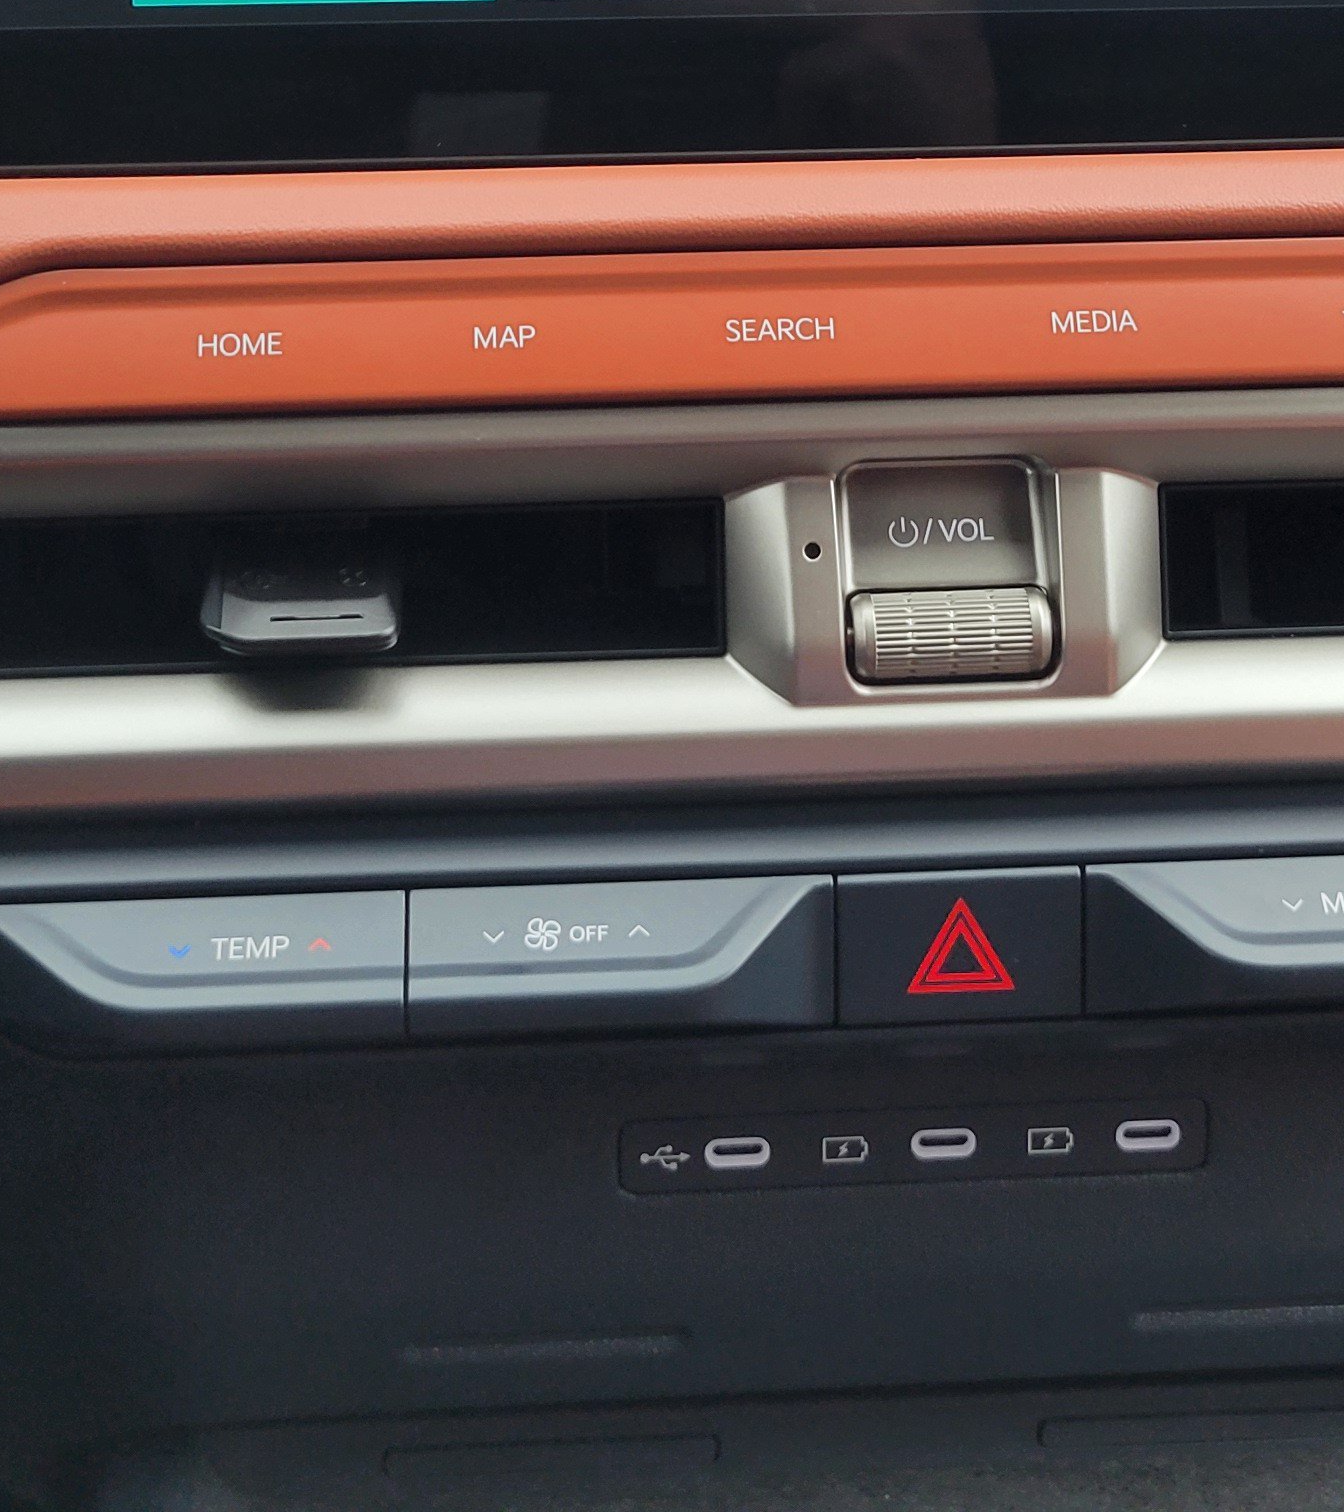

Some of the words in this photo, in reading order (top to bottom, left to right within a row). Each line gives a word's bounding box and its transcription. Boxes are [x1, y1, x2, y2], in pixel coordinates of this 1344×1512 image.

[725, 317, 835, 343] SEARCH
[1051, 309, 1138, 334] MEDIA
[198, 332, 283, 357] HOME
[473, 325, 536, 349] MAP
[569, 924, 609, 943] OFF
[210, 935, 290, 961] TEMP
